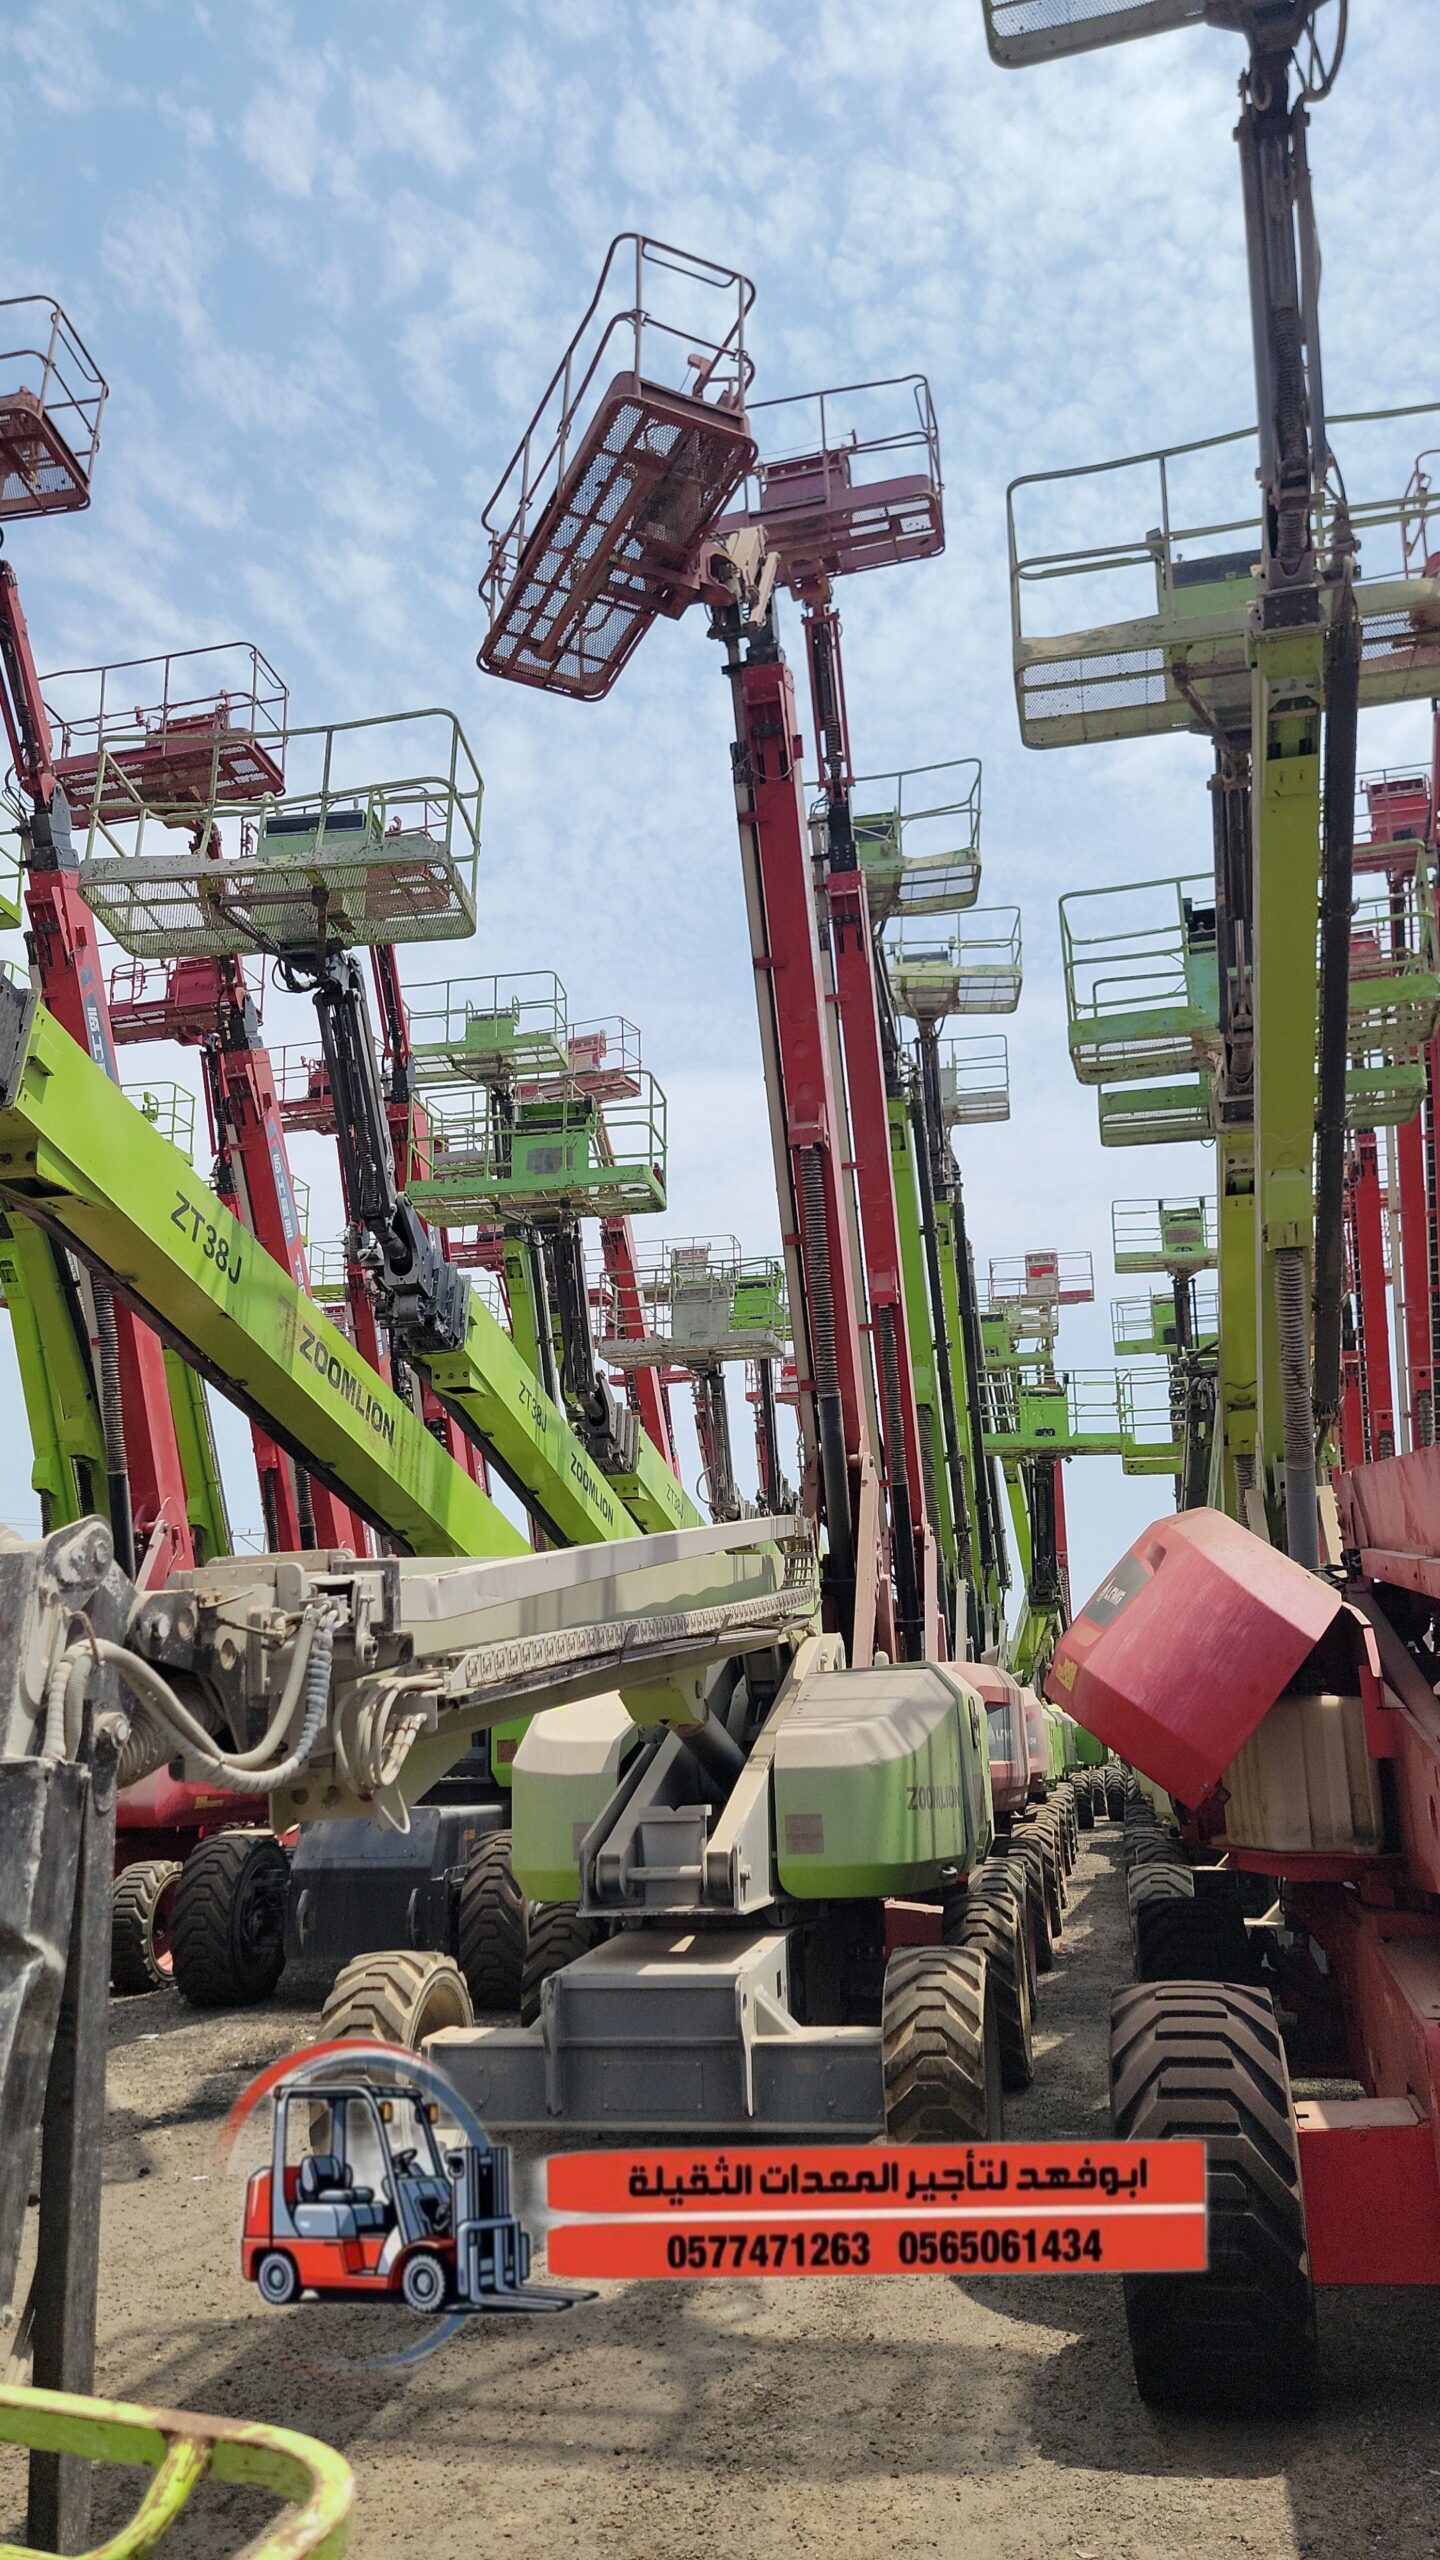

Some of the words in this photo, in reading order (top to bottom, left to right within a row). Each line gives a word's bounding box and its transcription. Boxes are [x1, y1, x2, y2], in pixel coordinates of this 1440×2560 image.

[170, 1190, 243, 1284] ZT38J
[299, 1325, 396, 1446] ZOOMLION
[518, 1380, 548, 1433] ZT38J
[570, 1451, 614, 1527] ZOOMLION
[666, 1482, 684, 1520] ZT38J
[906, 1785, 961, 1811] ZOOMLION
